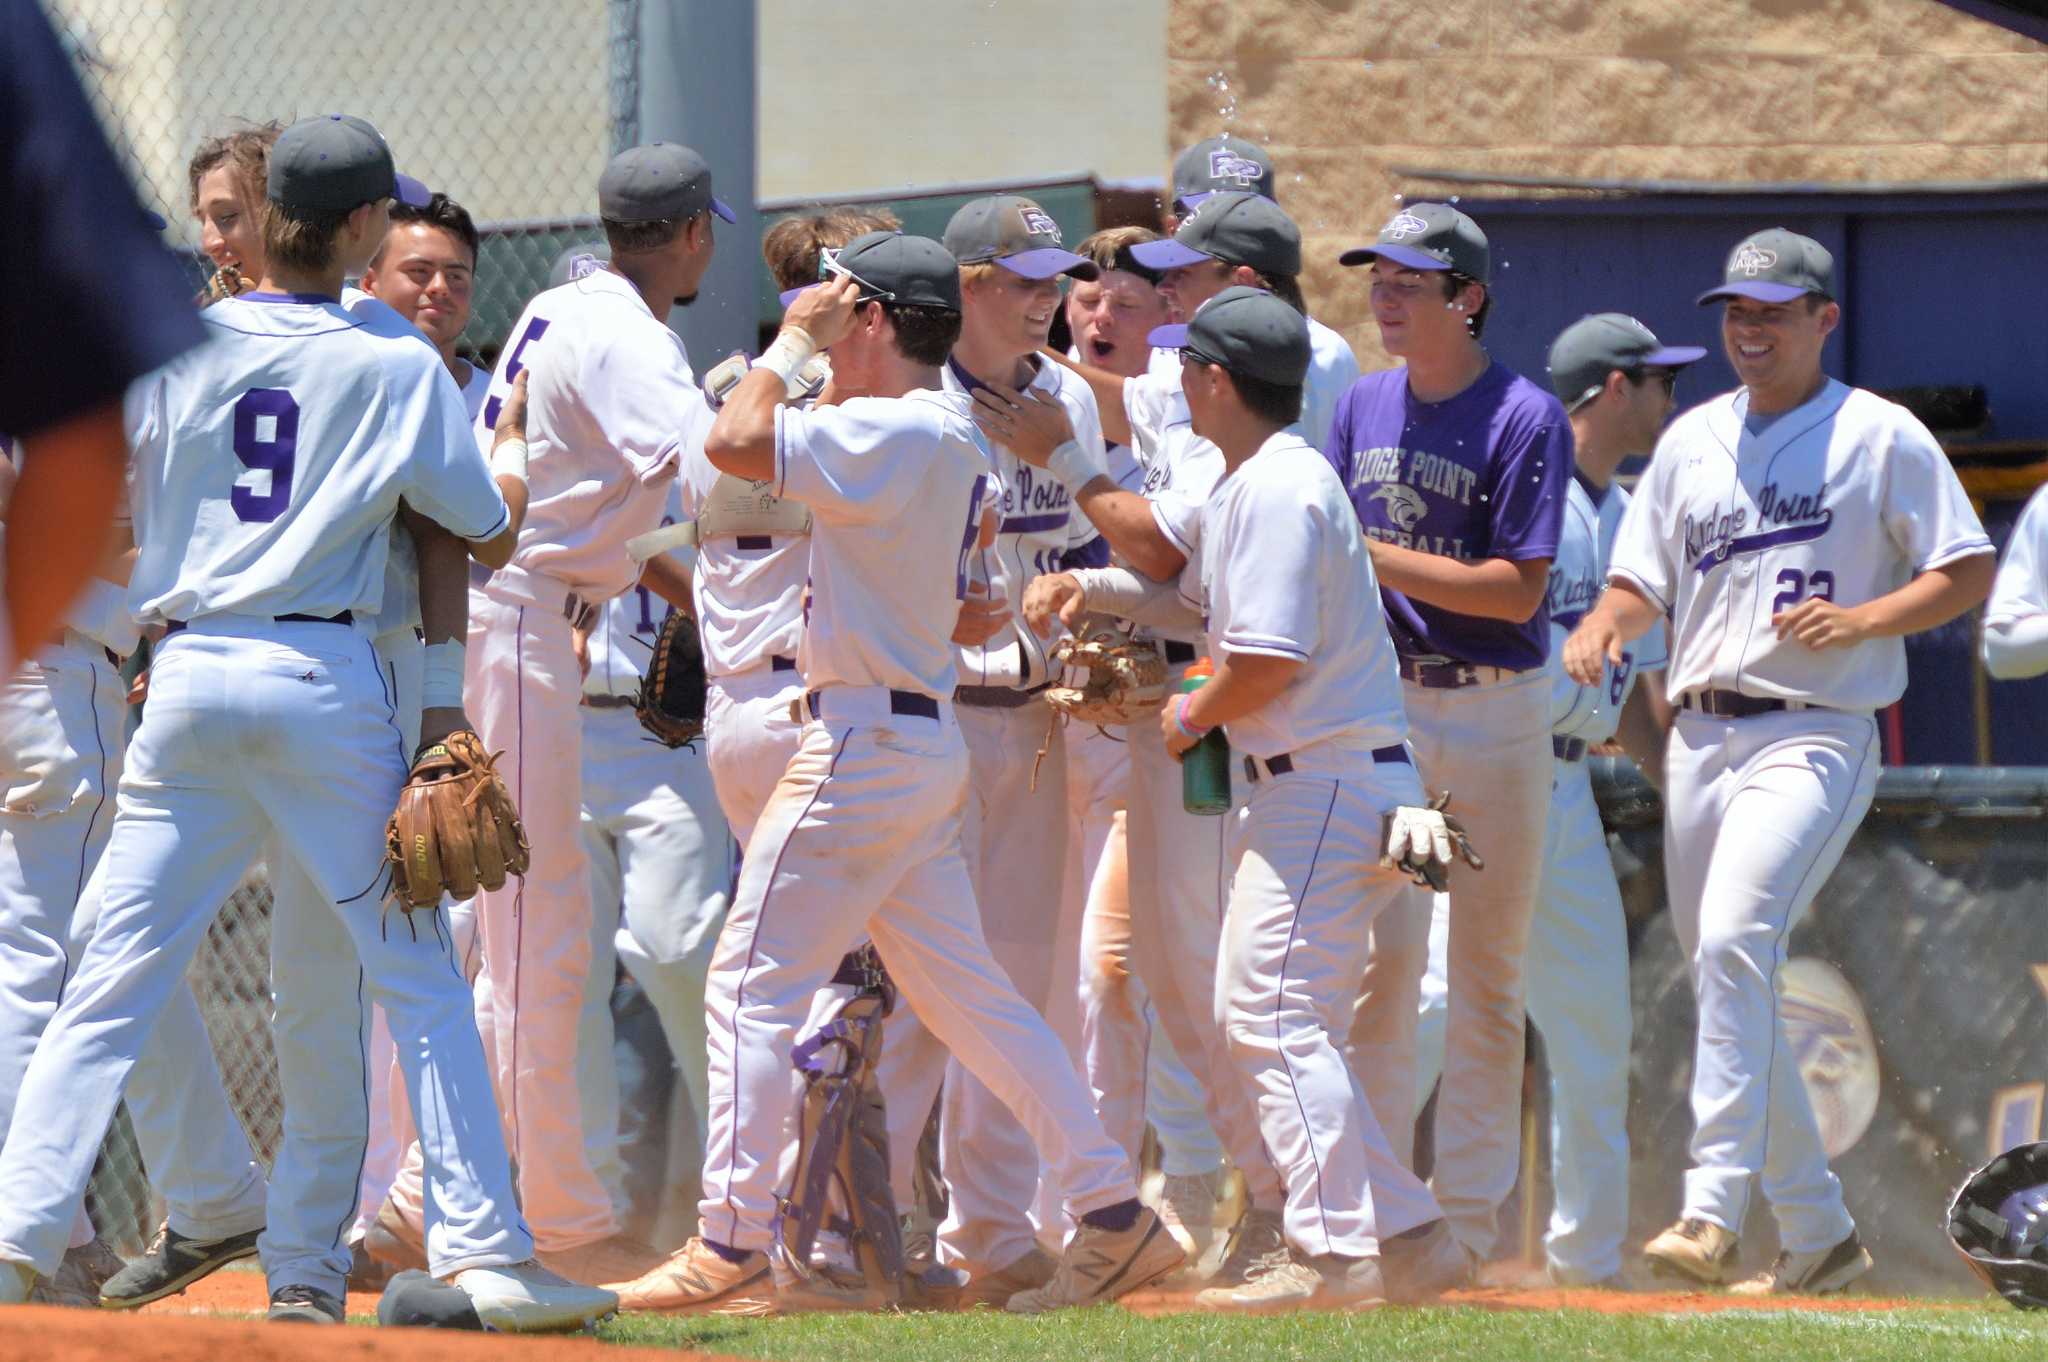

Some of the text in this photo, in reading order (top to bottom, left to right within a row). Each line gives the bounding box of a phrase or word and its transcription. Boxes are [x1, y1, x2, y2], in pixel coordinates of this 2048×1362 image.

[230, 387, 301, 524] 9
[1015, 464, 1072, 513] Poin
[1407, 450, 1477, 506] POINT
[1683, 481, 1830, 564] Ridge Point
